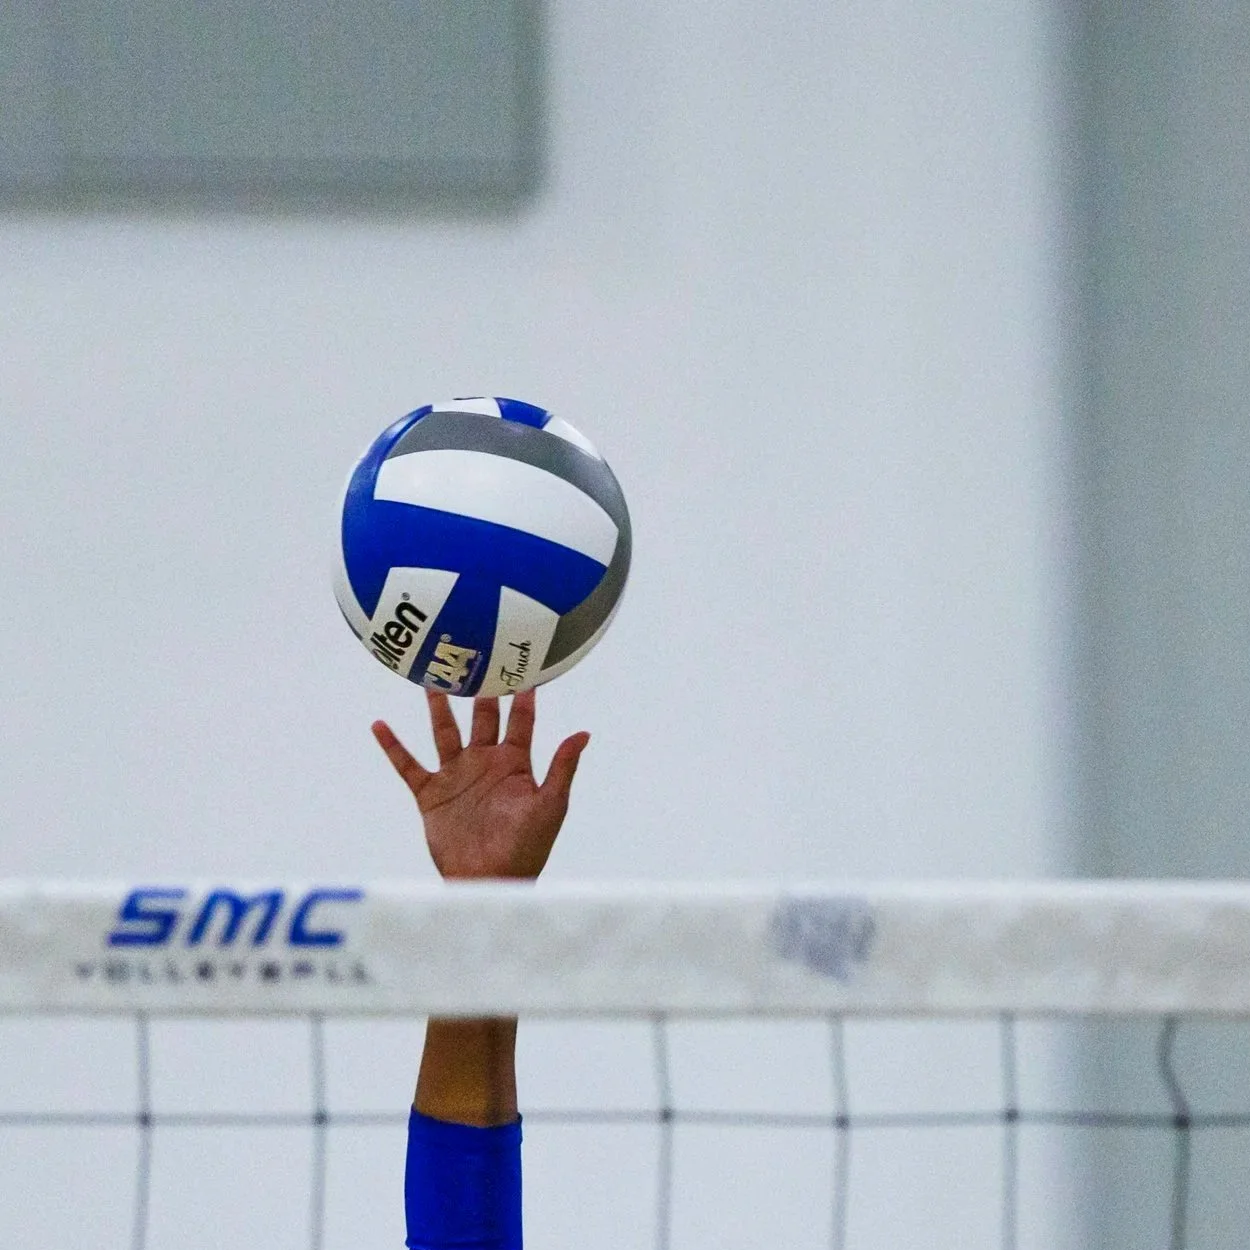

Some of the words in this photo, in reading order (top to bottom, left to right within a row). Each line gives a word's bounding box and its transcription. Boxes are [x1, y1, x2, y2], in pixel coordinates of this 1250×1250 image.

[370, 601, 428, 670] olten
[501, 640, 532, 687] Touch
[106, 886, 366, 947] SMC
